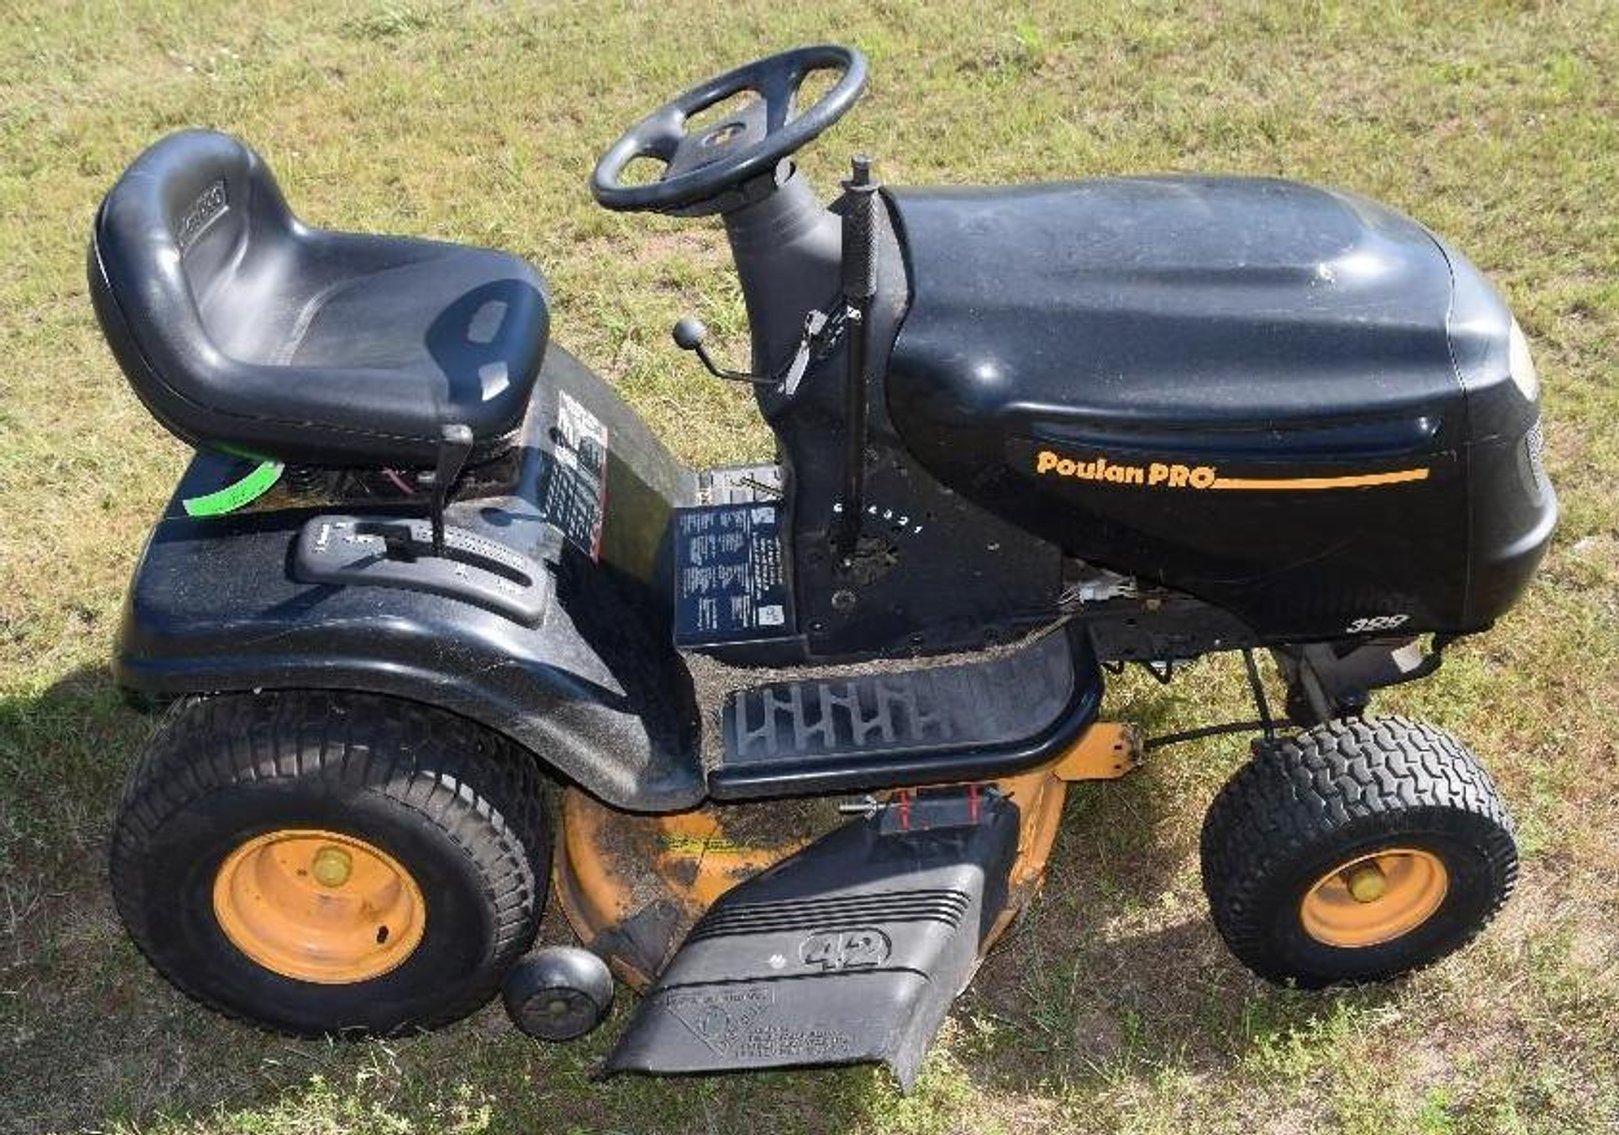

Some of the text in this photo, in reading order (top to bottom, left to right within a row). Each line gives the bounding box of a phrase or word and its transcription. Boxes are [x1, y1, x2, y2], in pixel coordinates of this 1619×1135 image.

[1037, 451, 1216, 489] Poulan PRO
[803, 931, 883, 970] 42
